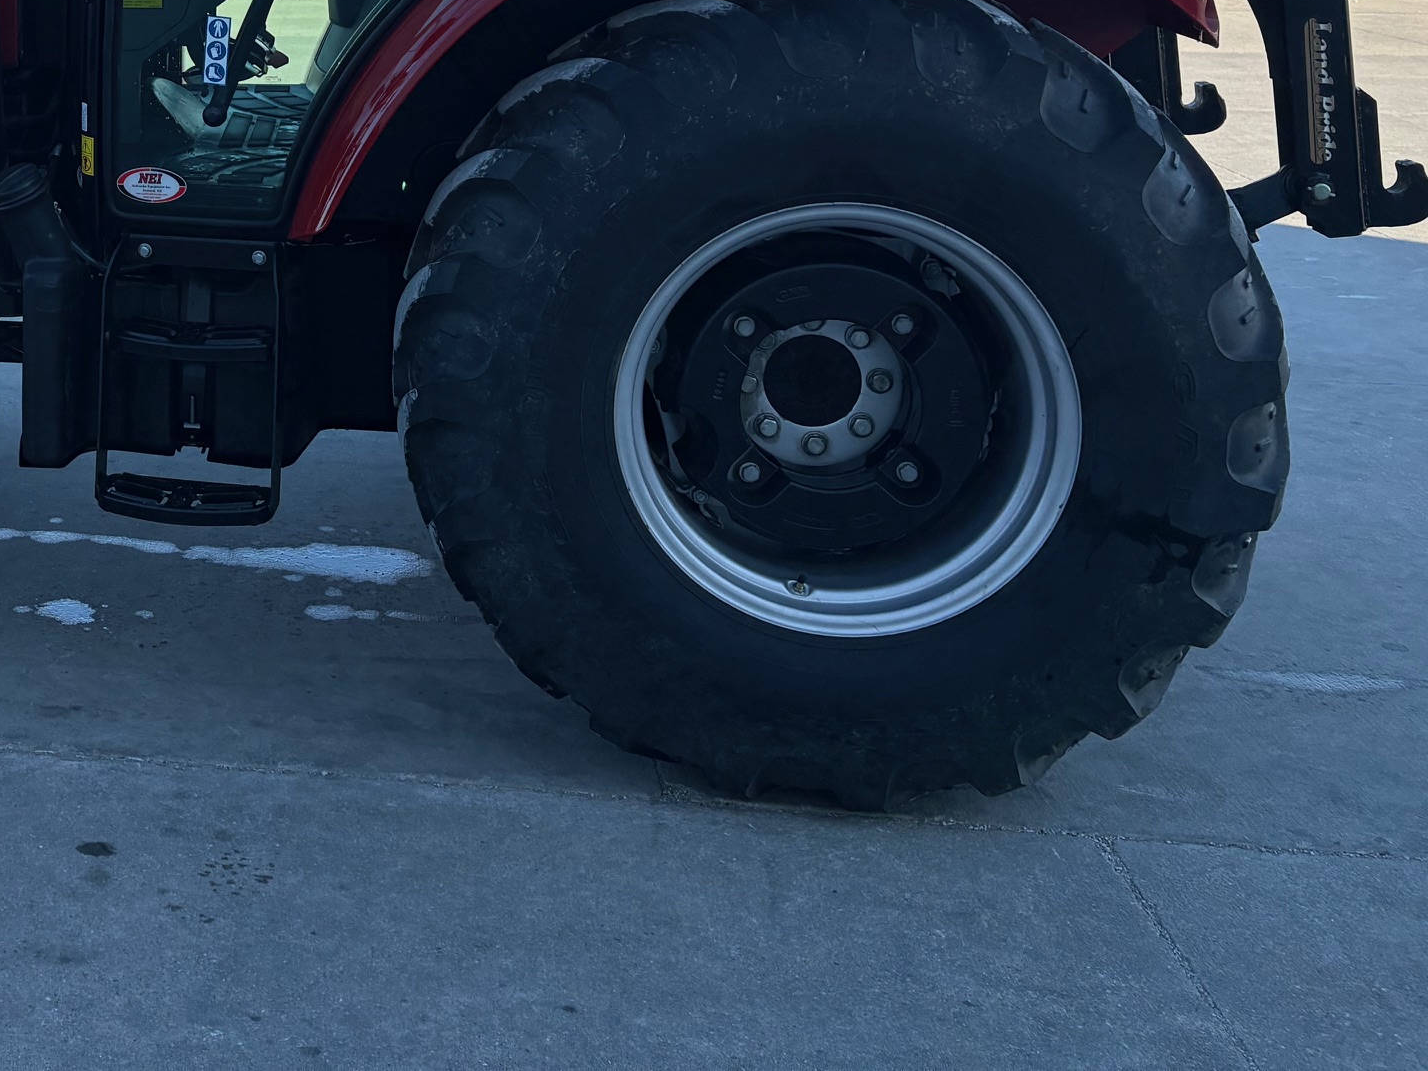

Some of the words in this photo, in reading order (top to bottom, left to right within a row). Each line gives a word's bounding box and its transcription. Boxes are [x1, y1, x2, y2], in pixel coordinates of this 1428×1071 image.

[1312, 22, 1335, 85] Land
[1314, 94, 1337, 162] Pride
[137, 172, 163, 185] NEI
